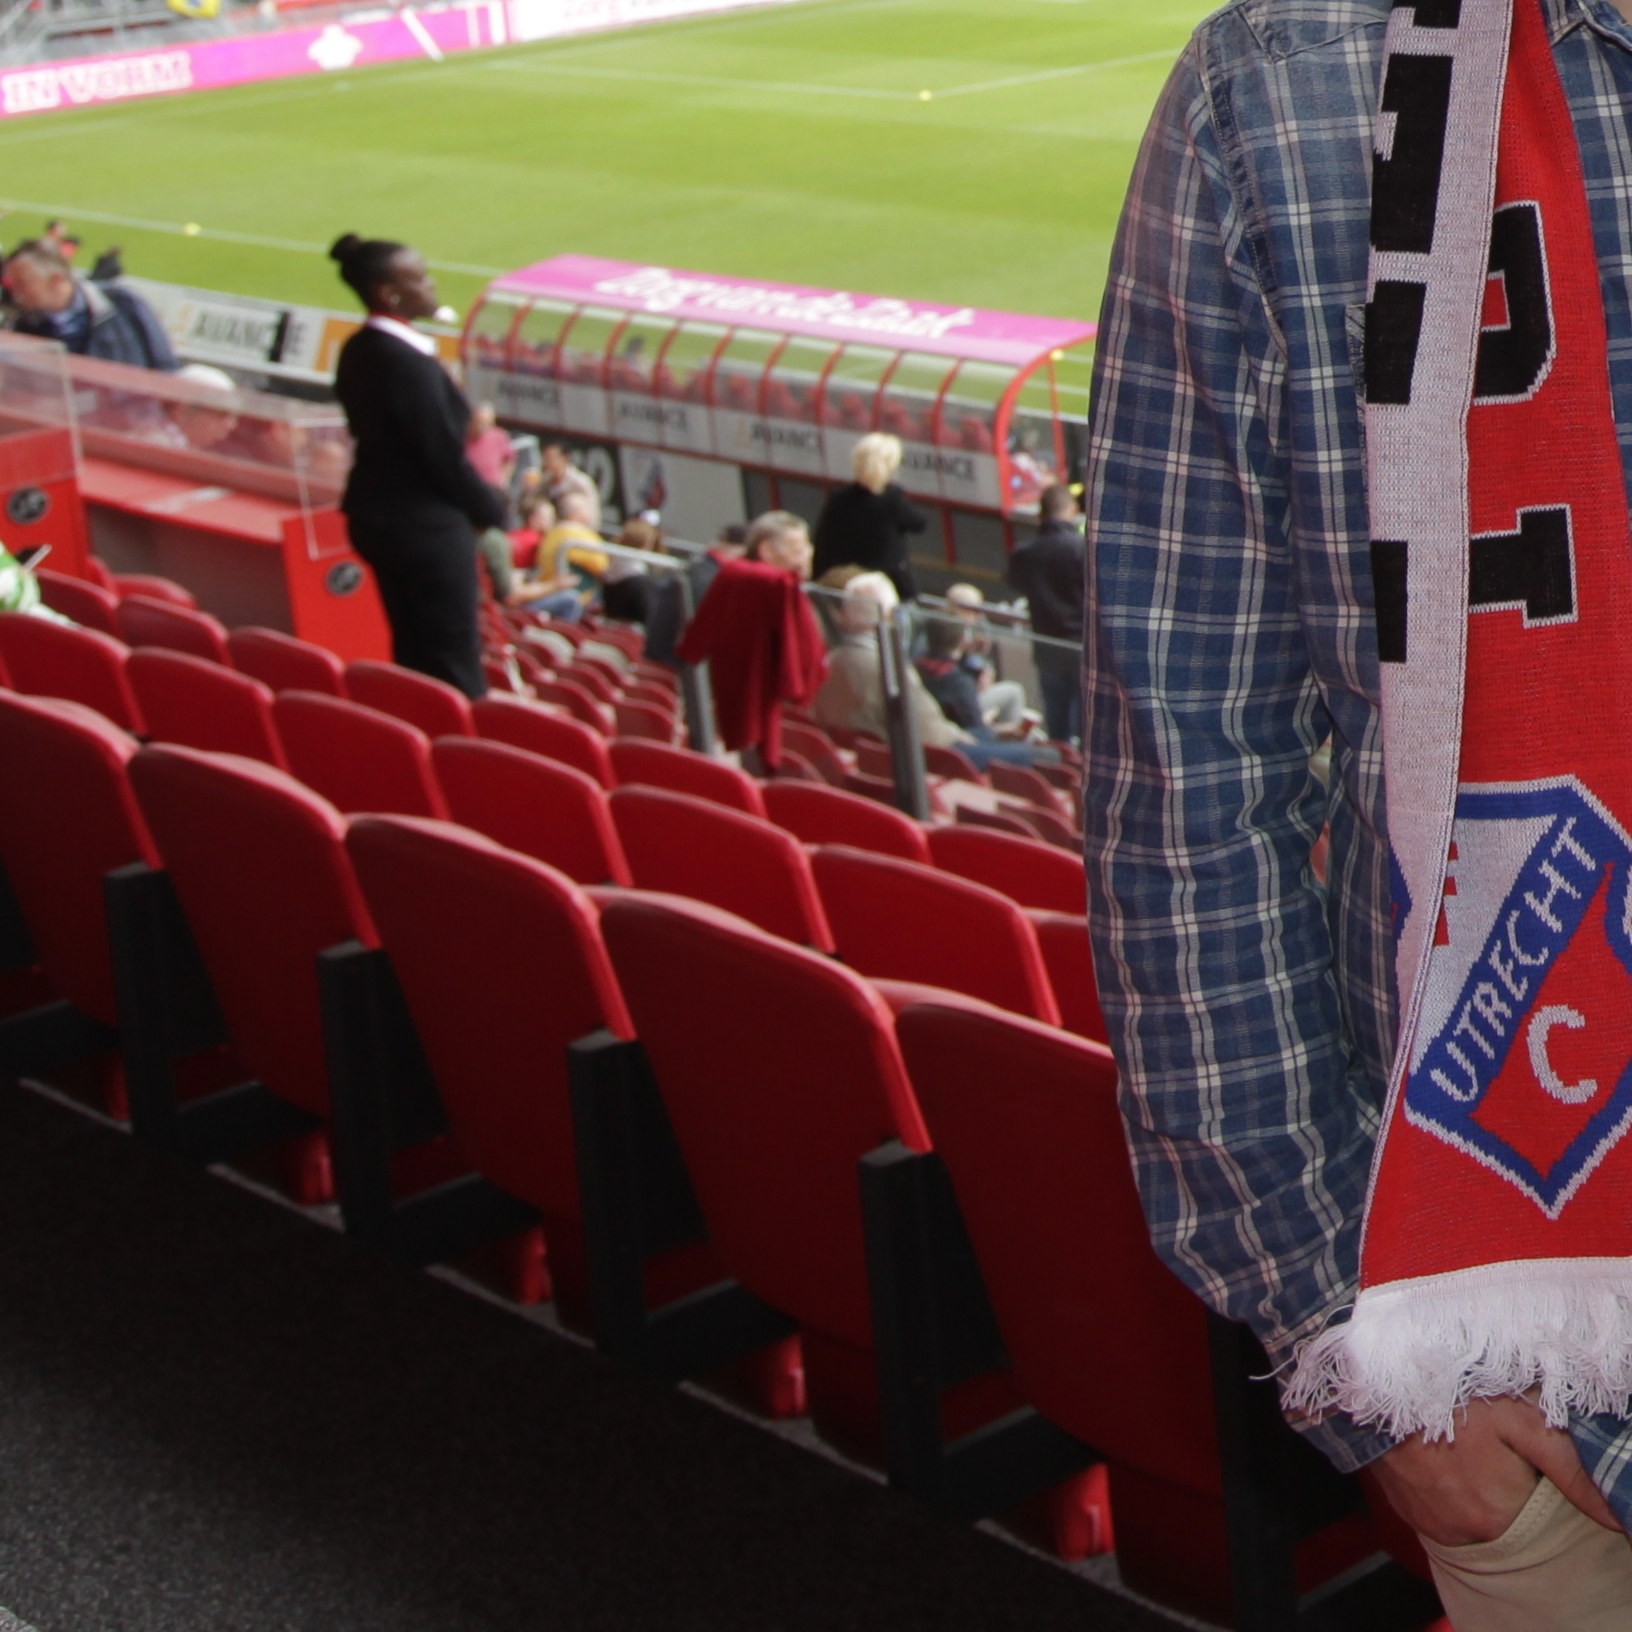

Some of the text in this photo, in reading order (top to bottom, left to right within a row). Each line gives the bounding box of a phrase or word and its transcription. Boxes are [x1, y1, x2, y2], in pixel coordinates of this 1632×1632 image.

[1, 50, 194, 114] IN VORM
[1430, 817, 1598, 1103] UTRECHT
[1526, 1004, 1598, 1104] C
